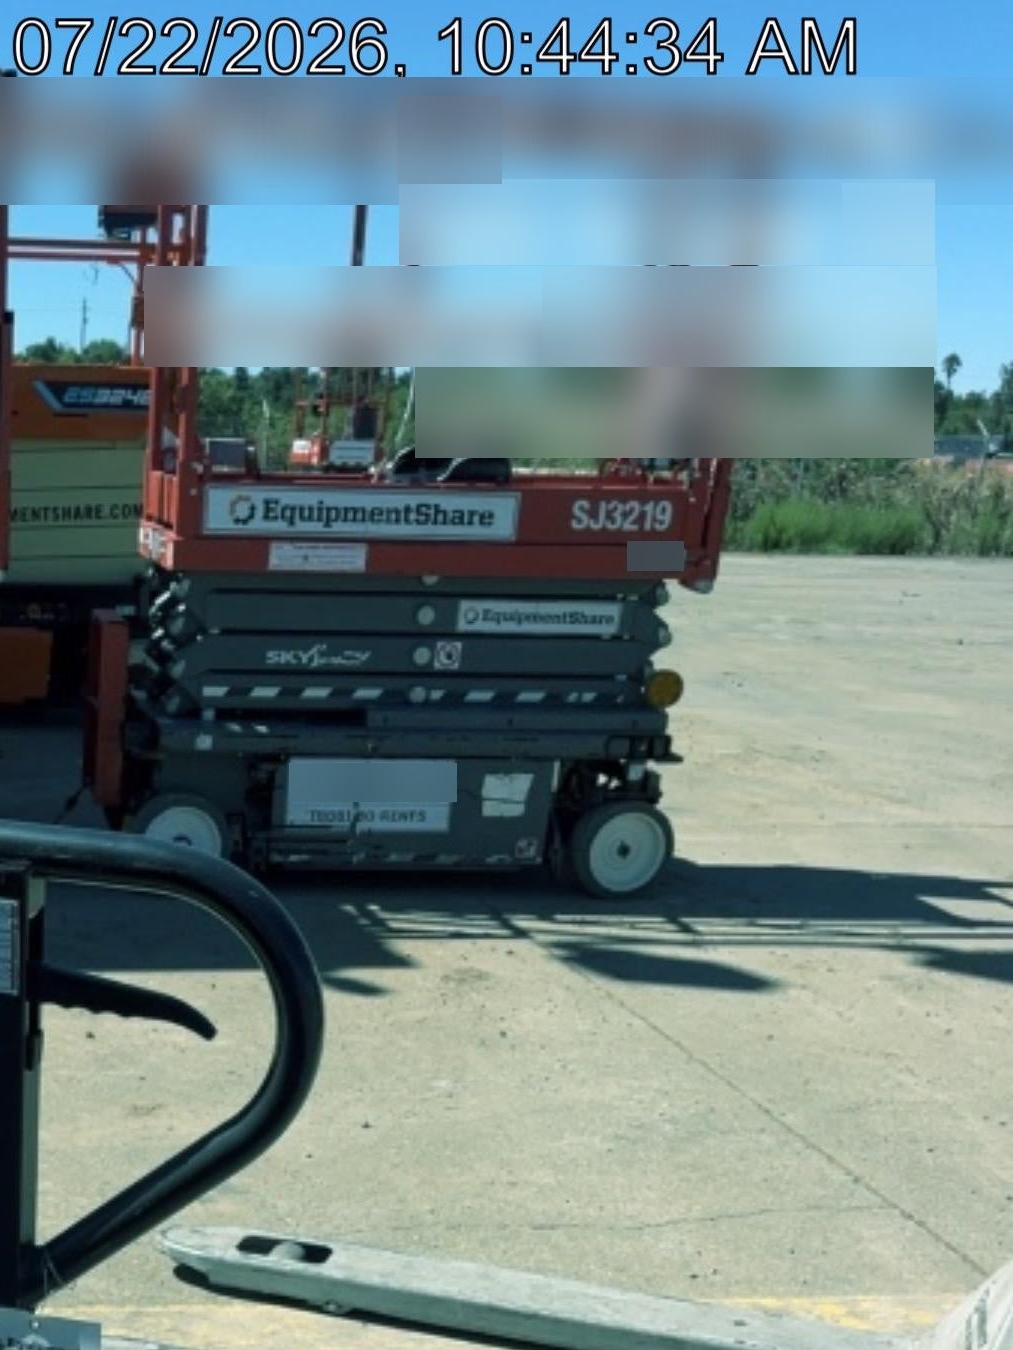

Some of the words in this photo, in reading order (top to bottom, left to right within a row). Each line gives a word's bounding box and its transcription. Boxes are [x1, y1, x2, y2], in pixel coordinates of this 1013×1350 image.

[263, 499, 494, 528] EquipmentShare
[572, 500, 672, 531] SJ3219
[482, 607, 615, 627] EquipmentShare
